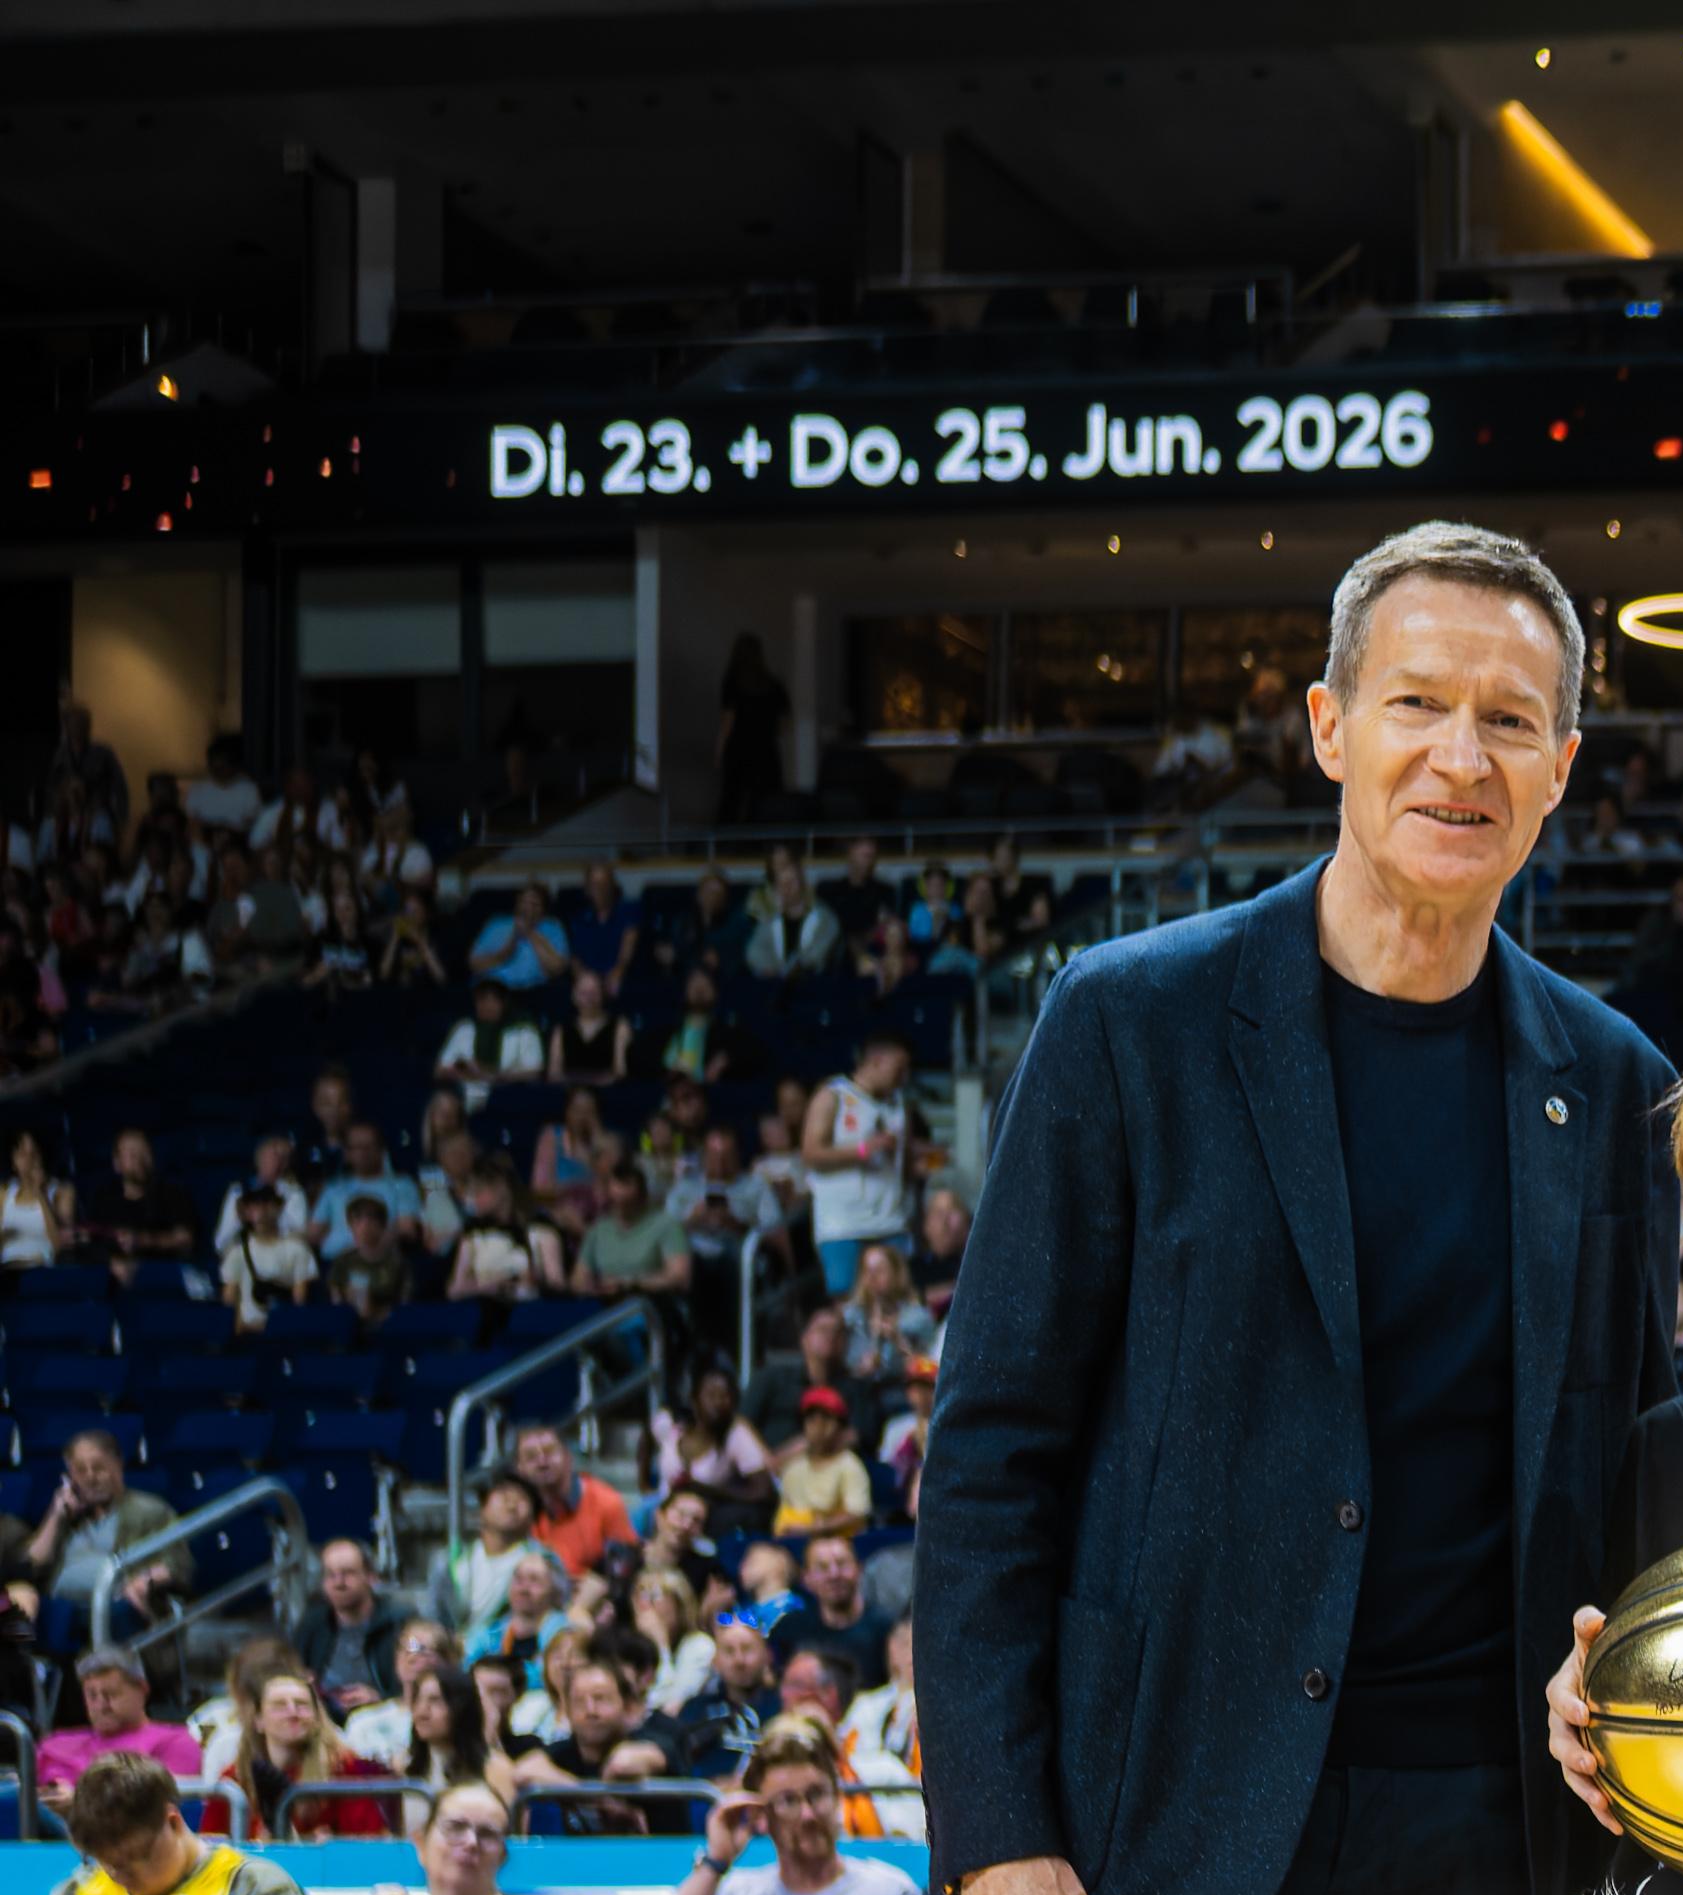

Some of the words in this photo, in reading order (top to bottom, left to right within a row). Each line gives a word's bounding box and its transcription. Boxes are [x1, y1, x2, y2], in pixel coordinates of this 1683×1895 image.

[491, 421, 584, 498] Di.
[601, 419, 711, 495] 23.
[729, 425, 772, 479] +
[791, 413, 919, 488] Do.
[936, 406, 1047, 482] 25.
[1062, 403, 1221, 480] Jun.
[1237, 390, 1434, 472] 2026
